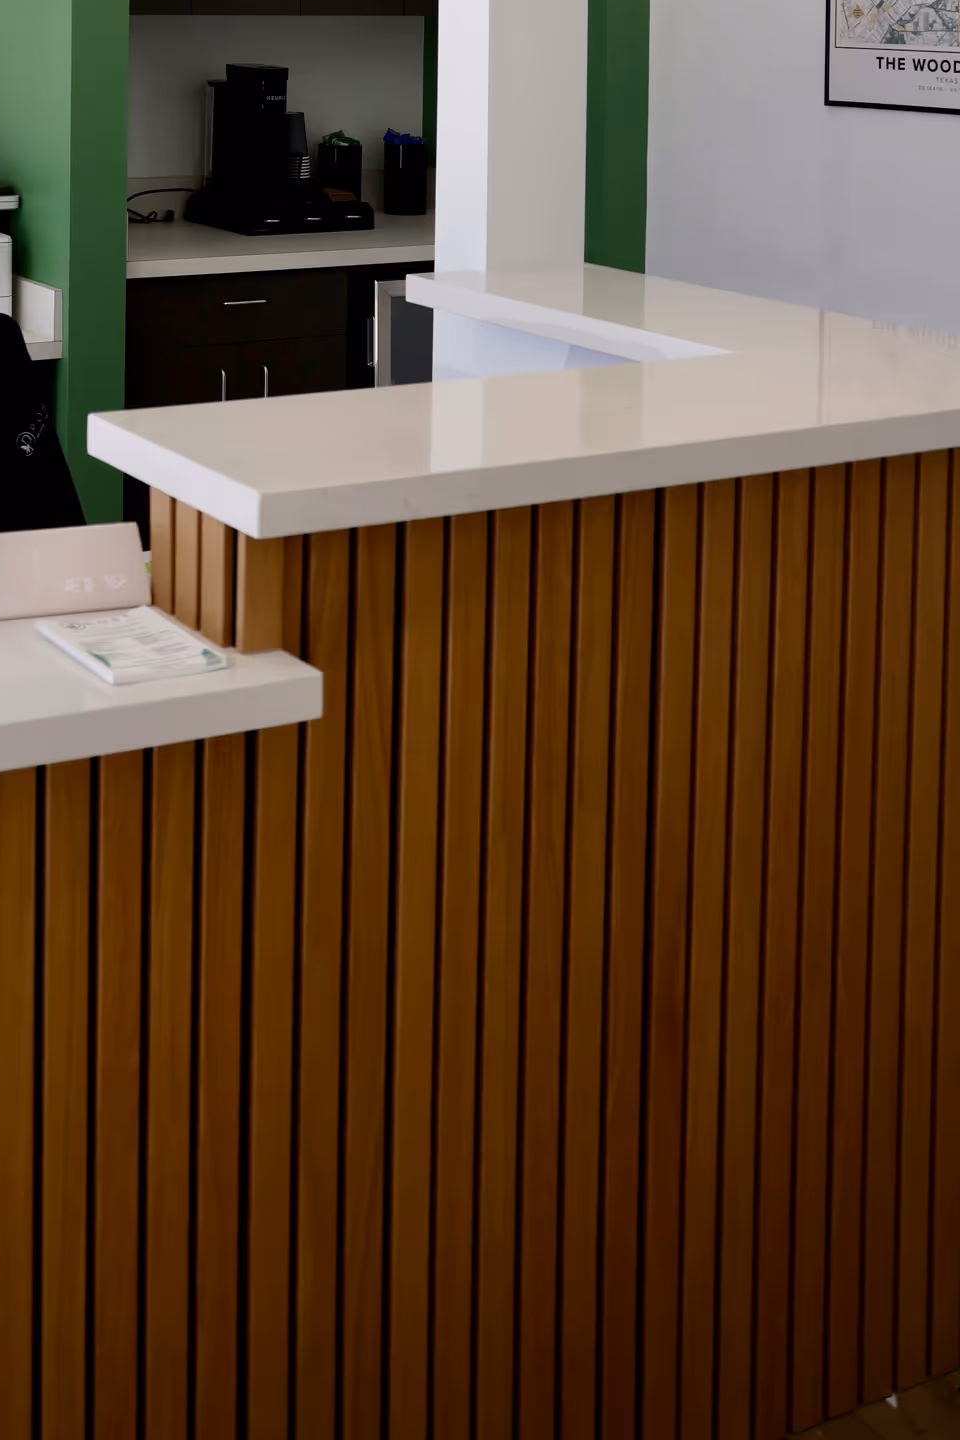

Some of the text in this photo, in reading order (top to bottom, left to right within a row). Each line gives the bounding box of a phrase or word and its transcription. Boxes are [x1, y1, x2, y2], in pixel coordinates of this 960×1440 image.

[876, 56, 960, 74] THE WOOD
[936, 76, 959, 85] TEXAS
